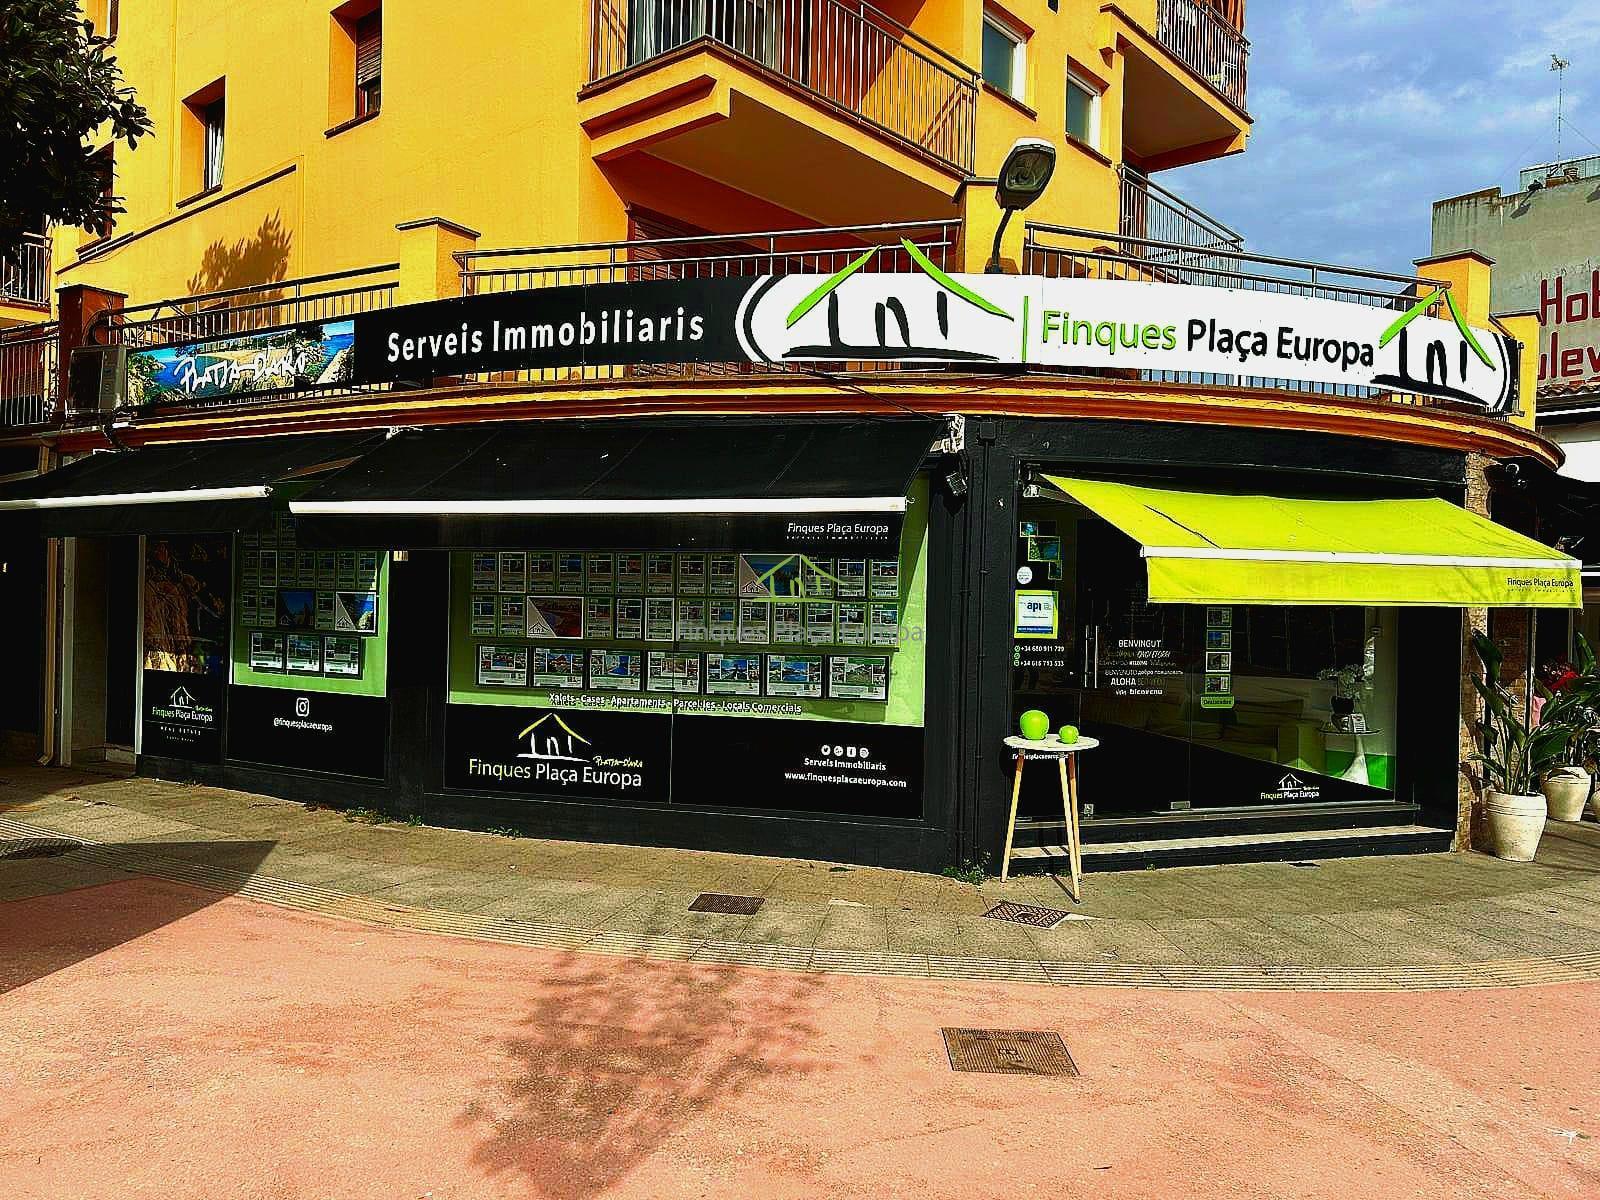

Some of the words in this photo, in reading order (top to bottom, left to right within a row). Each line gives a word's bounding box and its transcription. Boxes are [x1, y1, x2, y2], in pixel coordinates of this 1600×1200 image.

[387, 323, 483, 363] Serveis
[493, 306, 705, 351] Immobiliaris
[1042, 310, 1177, 354] Finques
[1187, 318, 1268, 362] Plaça
[1277, 326, 1374, 372] Europa
[787, 523, 825, 534] Finques
[827, 523, 852, 535] Plaça
[854, 523, 889, 535] Europa
[1507, 578, 1532, 587] Finques
[1534, 578, 1550, 587] Plaça
[1552, 579, 1574, 588] Europa
[1118, 639, 1162, 648] BENVINGUT
[1110, 677, 1137, 686] ALOHA
[581, 694, 604, 703] Cases
[611, 695, 666, 707] Apartaments
[722, 700, 750, 710] Locals
[752, 702, 802, 713] Comercials
[152, 706, 175, 718] Finques
[175, 709, 191, 720] Plaça
[191, 711, 213, 723] Europa
[804, 757, 833, 768] Serveis
[834, 759, 887, 771] Immobiliaris
[469, 758, 531, 780] Finques
[536, 763, 578, 785] Plaça
[583, 766, 642, 789] Europa
[784, 772, 907, 787] www.finquesplacaeuropa.com
[1260, 792, 1282, 800] Finques
[1283, 791, 1299, 800] Plaça
[1299, 790, 1320, 798] Europa
